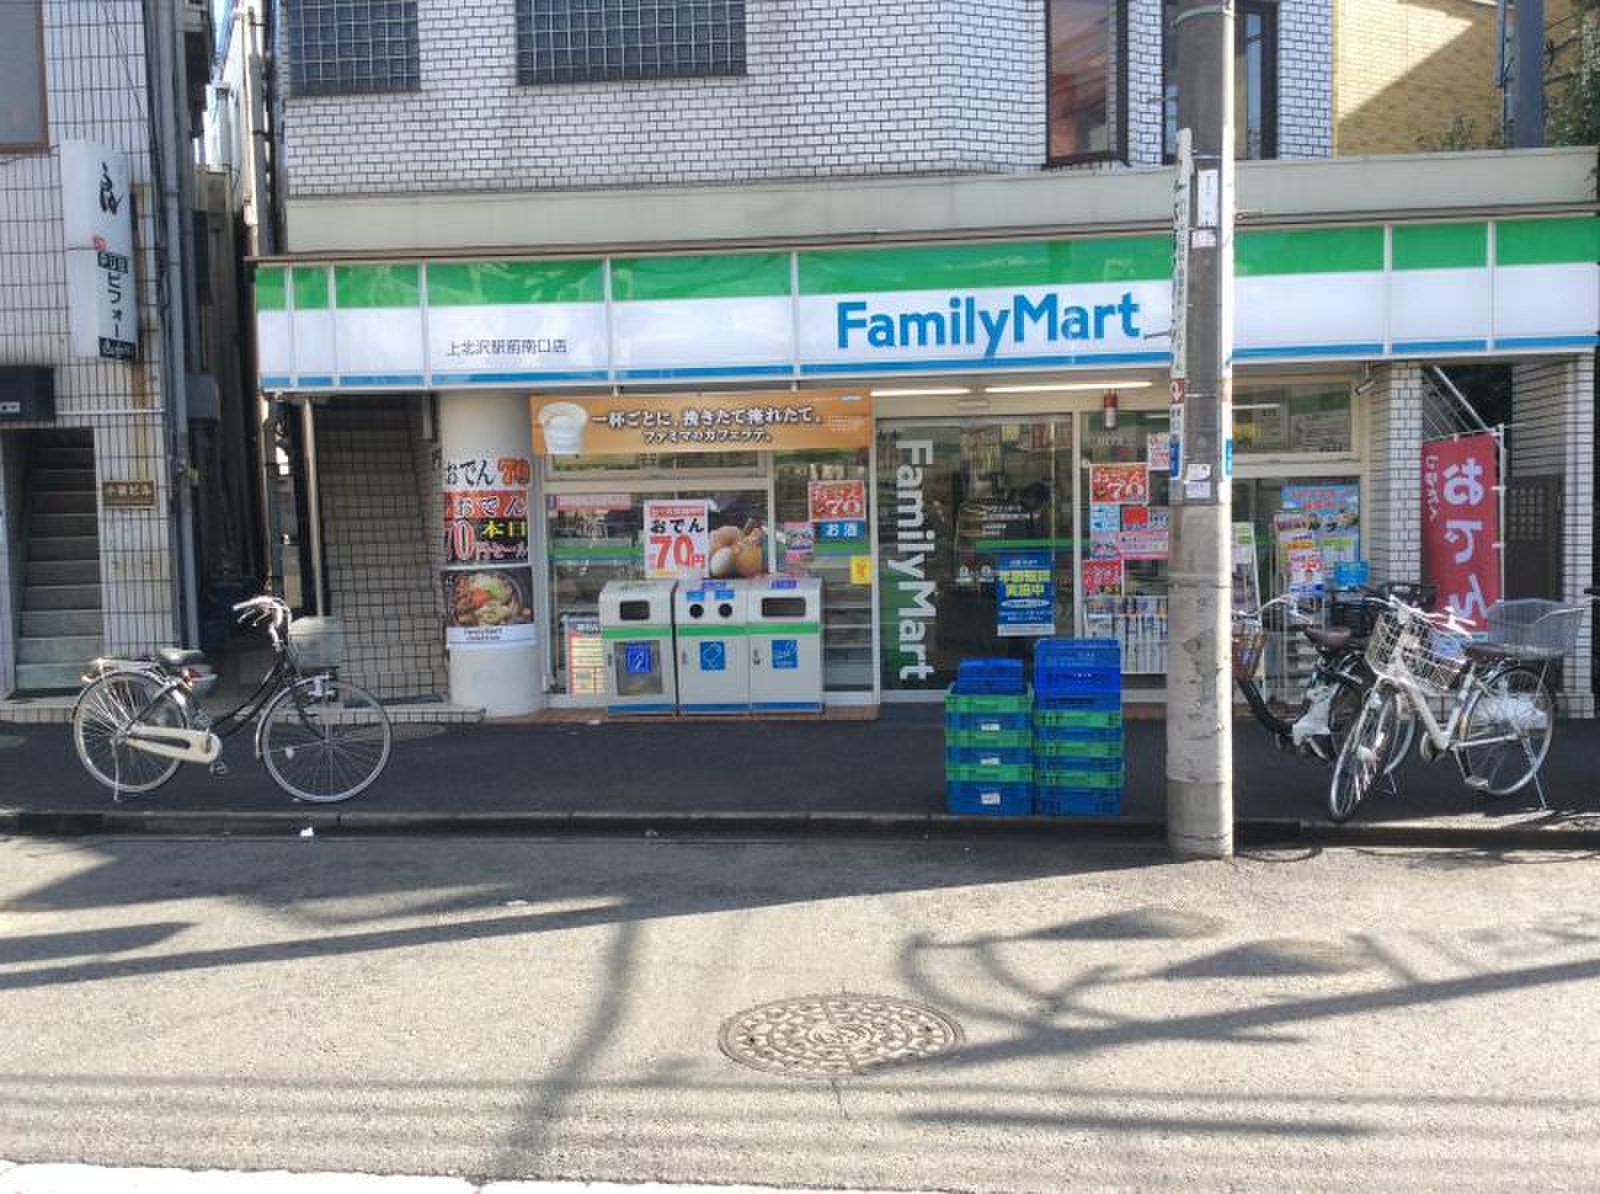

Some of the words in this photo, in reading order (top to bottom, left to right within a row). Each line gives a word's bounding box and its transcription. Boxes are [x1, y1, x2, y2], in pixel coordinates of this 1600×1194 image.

[837, 292, 1140, 358] FamilyMart
[447, 338, 567, 356] 上北沢駅前南口店
[481, 520, 527, 539] 本日
[650, 517, 704, 534] おでん
[888, 439, 937, 680] FamilyMart
